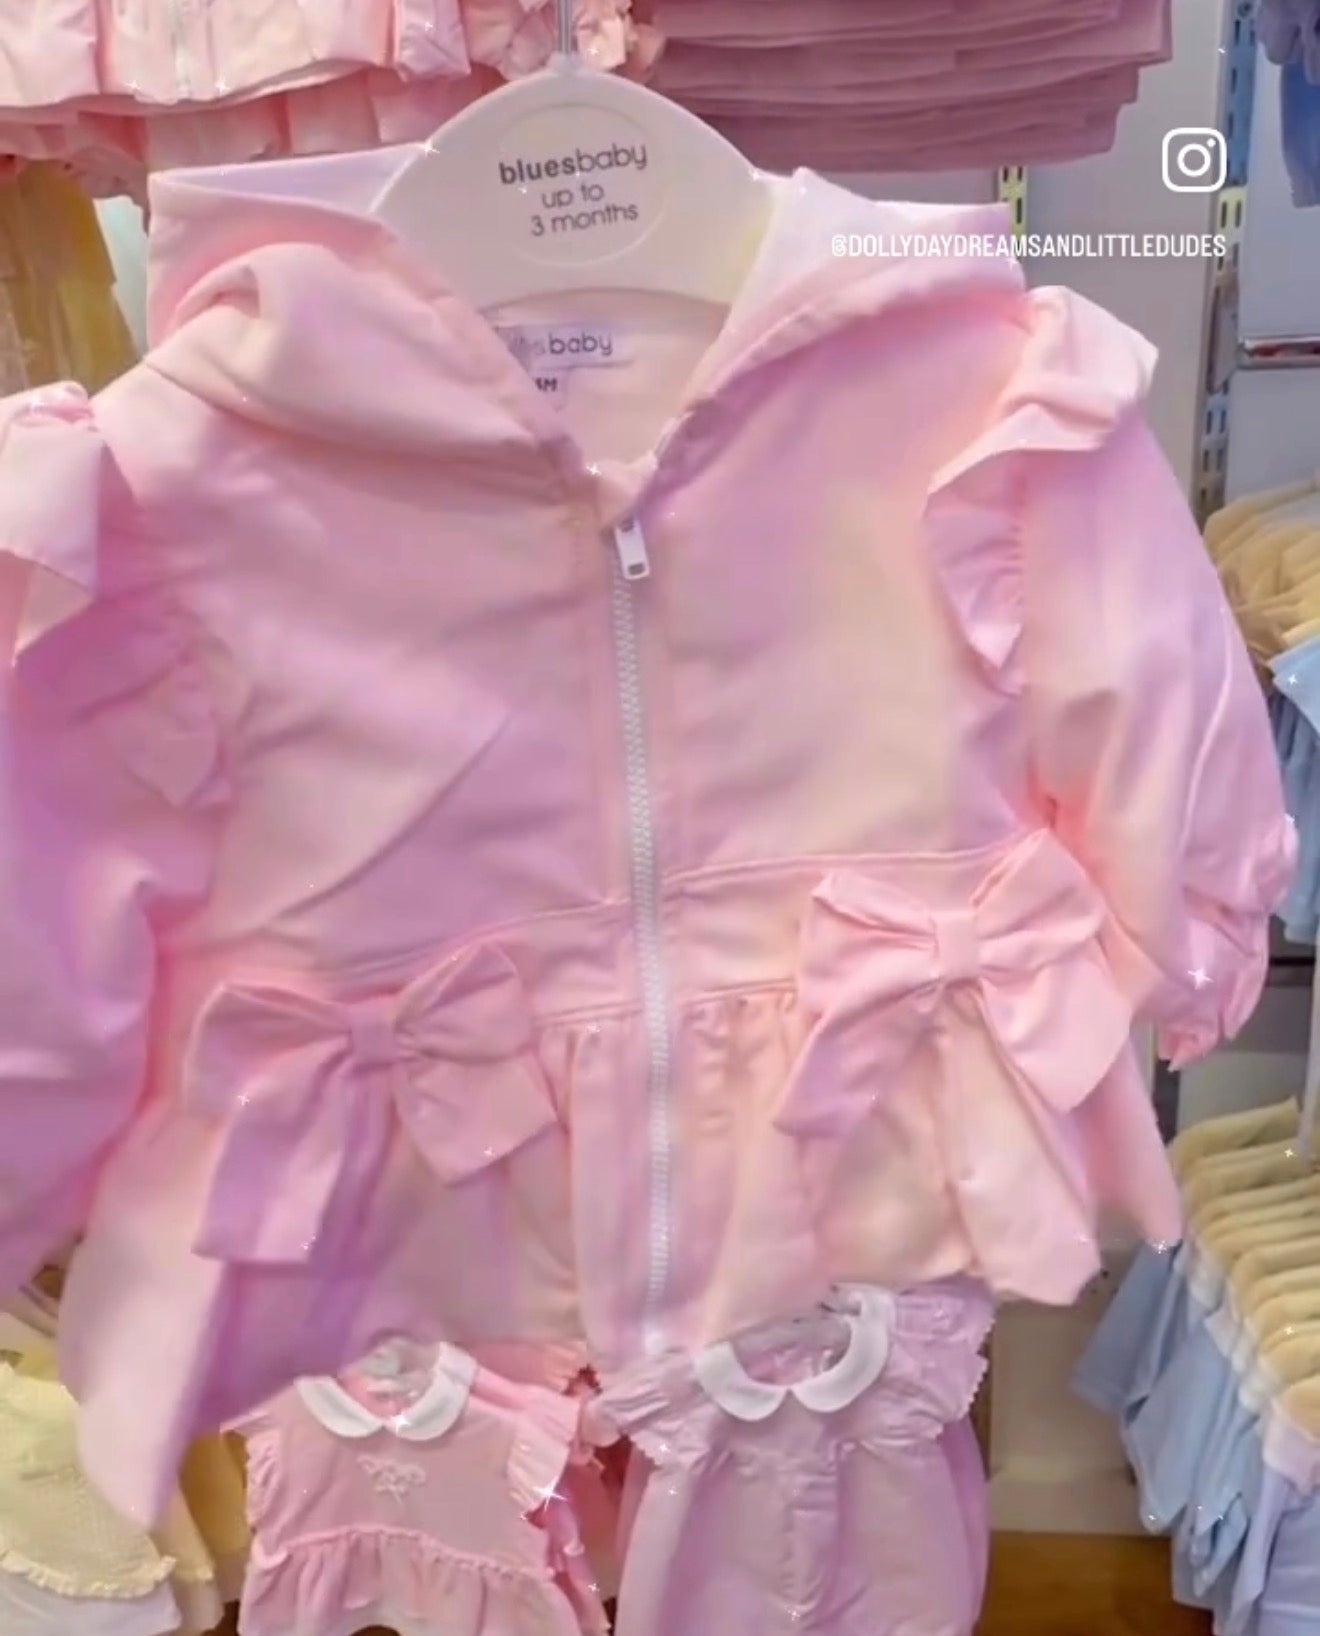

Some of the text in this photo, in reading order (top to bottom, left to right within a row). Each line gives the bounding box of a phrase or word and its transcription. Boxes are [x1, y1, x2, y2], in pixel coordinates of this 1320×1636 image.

[499, 143, 647, 184] bluesbaby
[542, 183, 605, 208] up to
[531, 203, 638, 236] 3 months
